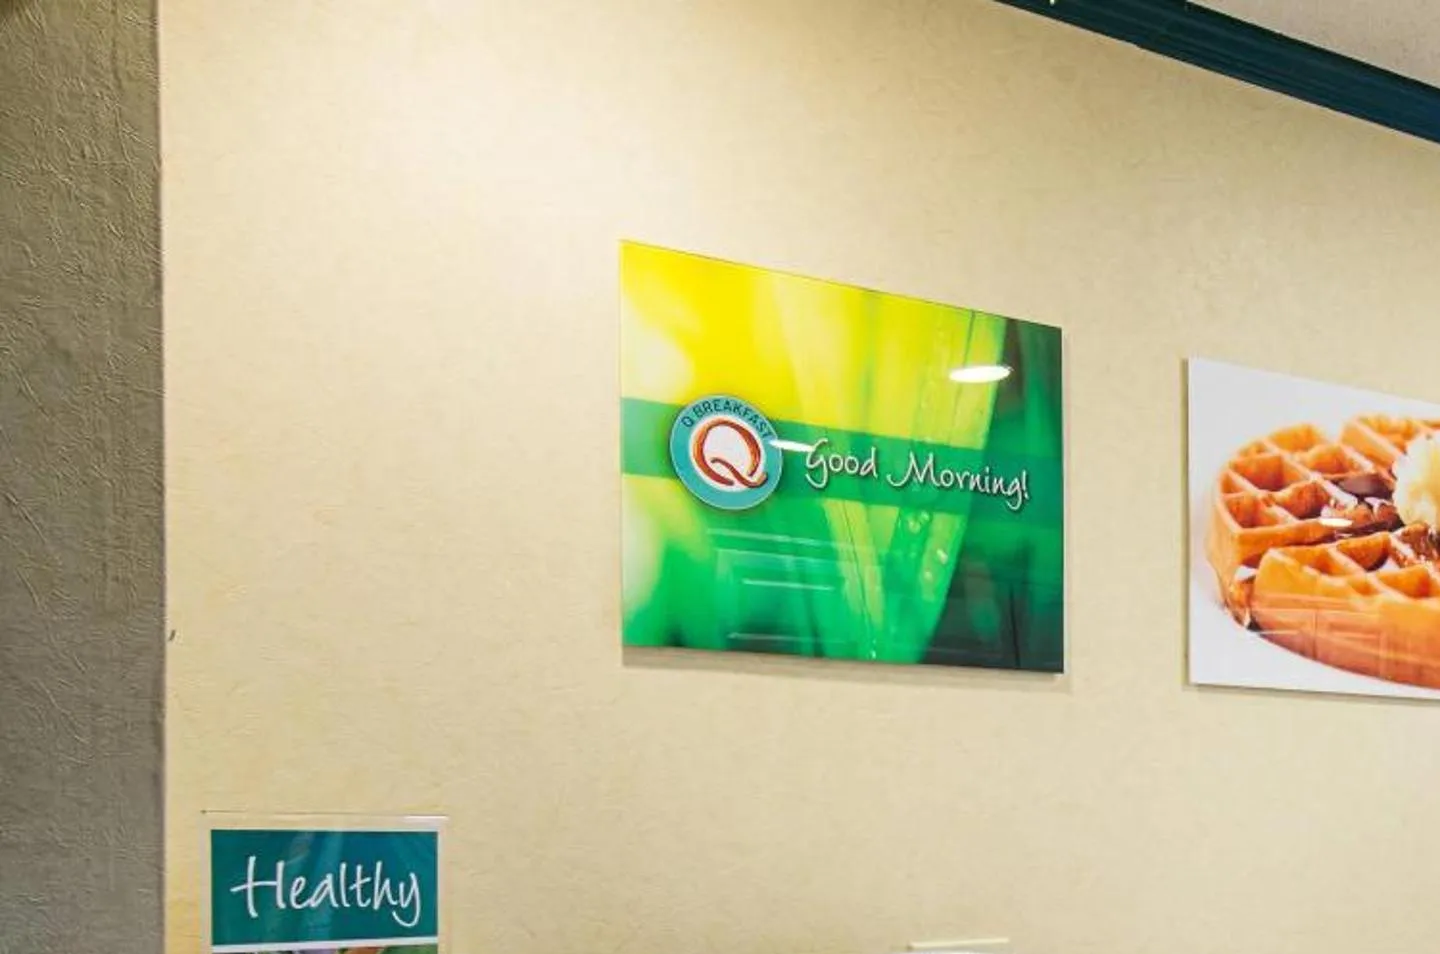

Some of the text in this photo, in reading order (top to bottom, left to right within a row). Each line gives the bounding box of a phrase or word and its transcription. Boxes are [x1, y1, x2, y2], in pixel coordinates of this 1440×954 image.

[692, 398, 774, 438] BREAKFAST
[692, 416, 769, 488] Q
[804, 437, 1031, 512] Good Morning!
[229, 855, 422, 928] Healthy
